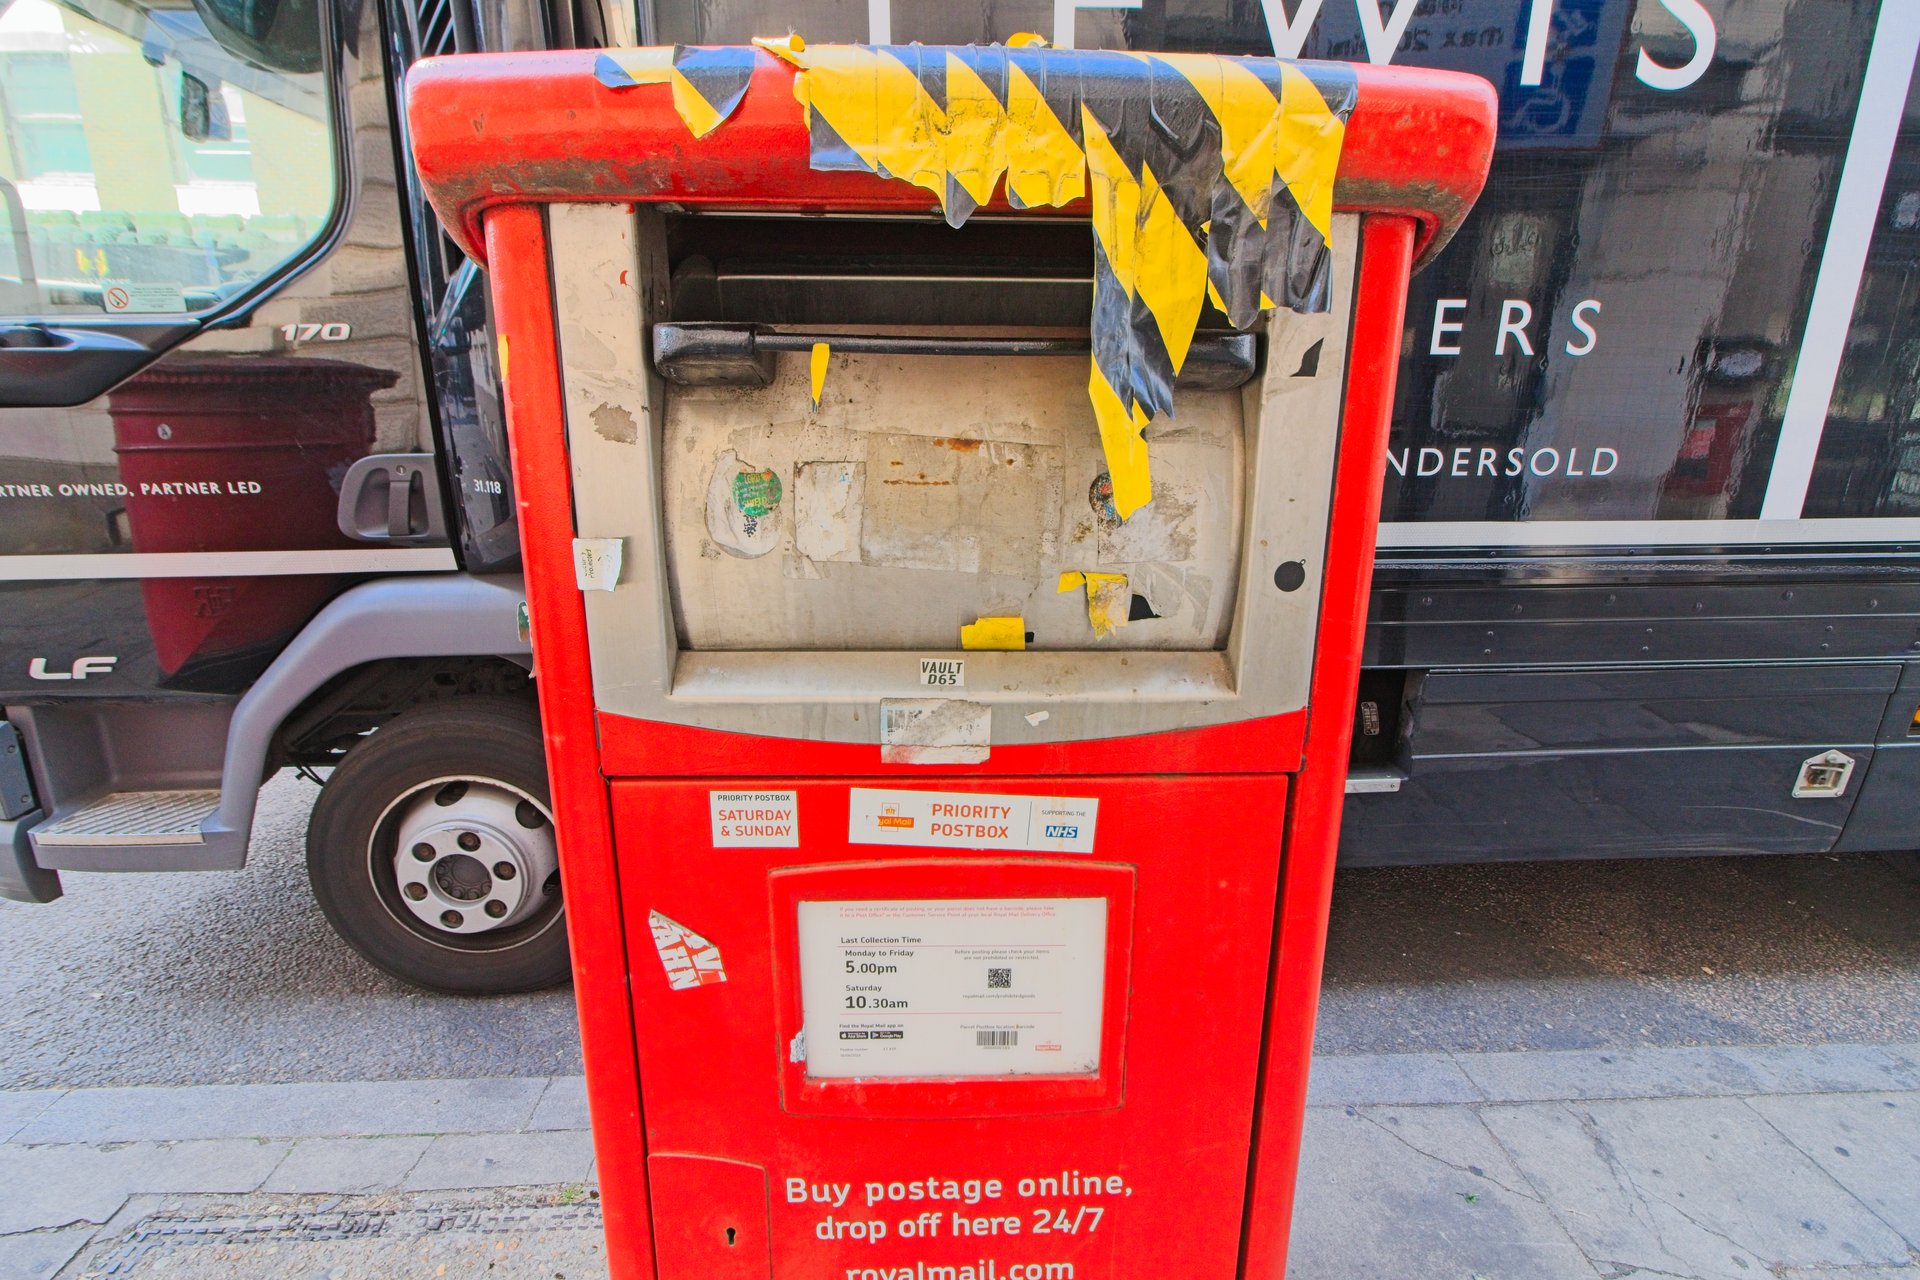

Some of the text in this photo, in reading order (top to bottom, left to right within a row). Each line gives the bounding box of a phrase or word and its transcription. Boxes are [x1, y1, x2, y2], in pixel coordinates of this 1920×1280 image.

[281, 323, 351, 341] 170
[1429, 299, 1602, 357] ERS
[58, 483, 135, 497] OWNED,
[140, 482, 222, 496] PARTNER
[227, 481, 262, 495] LED
[473, 479, 502, 494] 31.118
[29, 656, 118, 680] LF
[921, 661, 963, 674] VAULT
[927, 674, 957, 685] D65
[717, 794, 791, 802] PRIORITY POSTBOX
[718, 809, 792, 821] SATURDAY
[932, 803, 1011, 819] PRIORITY
[1041, 809, 1075, 817] SUPPORTING
[893, 818, 912, 827] Mail
[721, 825, 792, 837] & SUNDAY
[931, 823, 1009, 839] POSTBOX
[1046, 826, 1077, 838] NHS
[845, 960, 897, 975] 5.00pm
[845, 996, 908, 1008] 10.30am
[786, 1170, 1133, 1207] Buy postage online,
[815, 1206, 1105, 1244] drop off here 24/7
[846, 1259, 1074, 1280] royalmail.com
